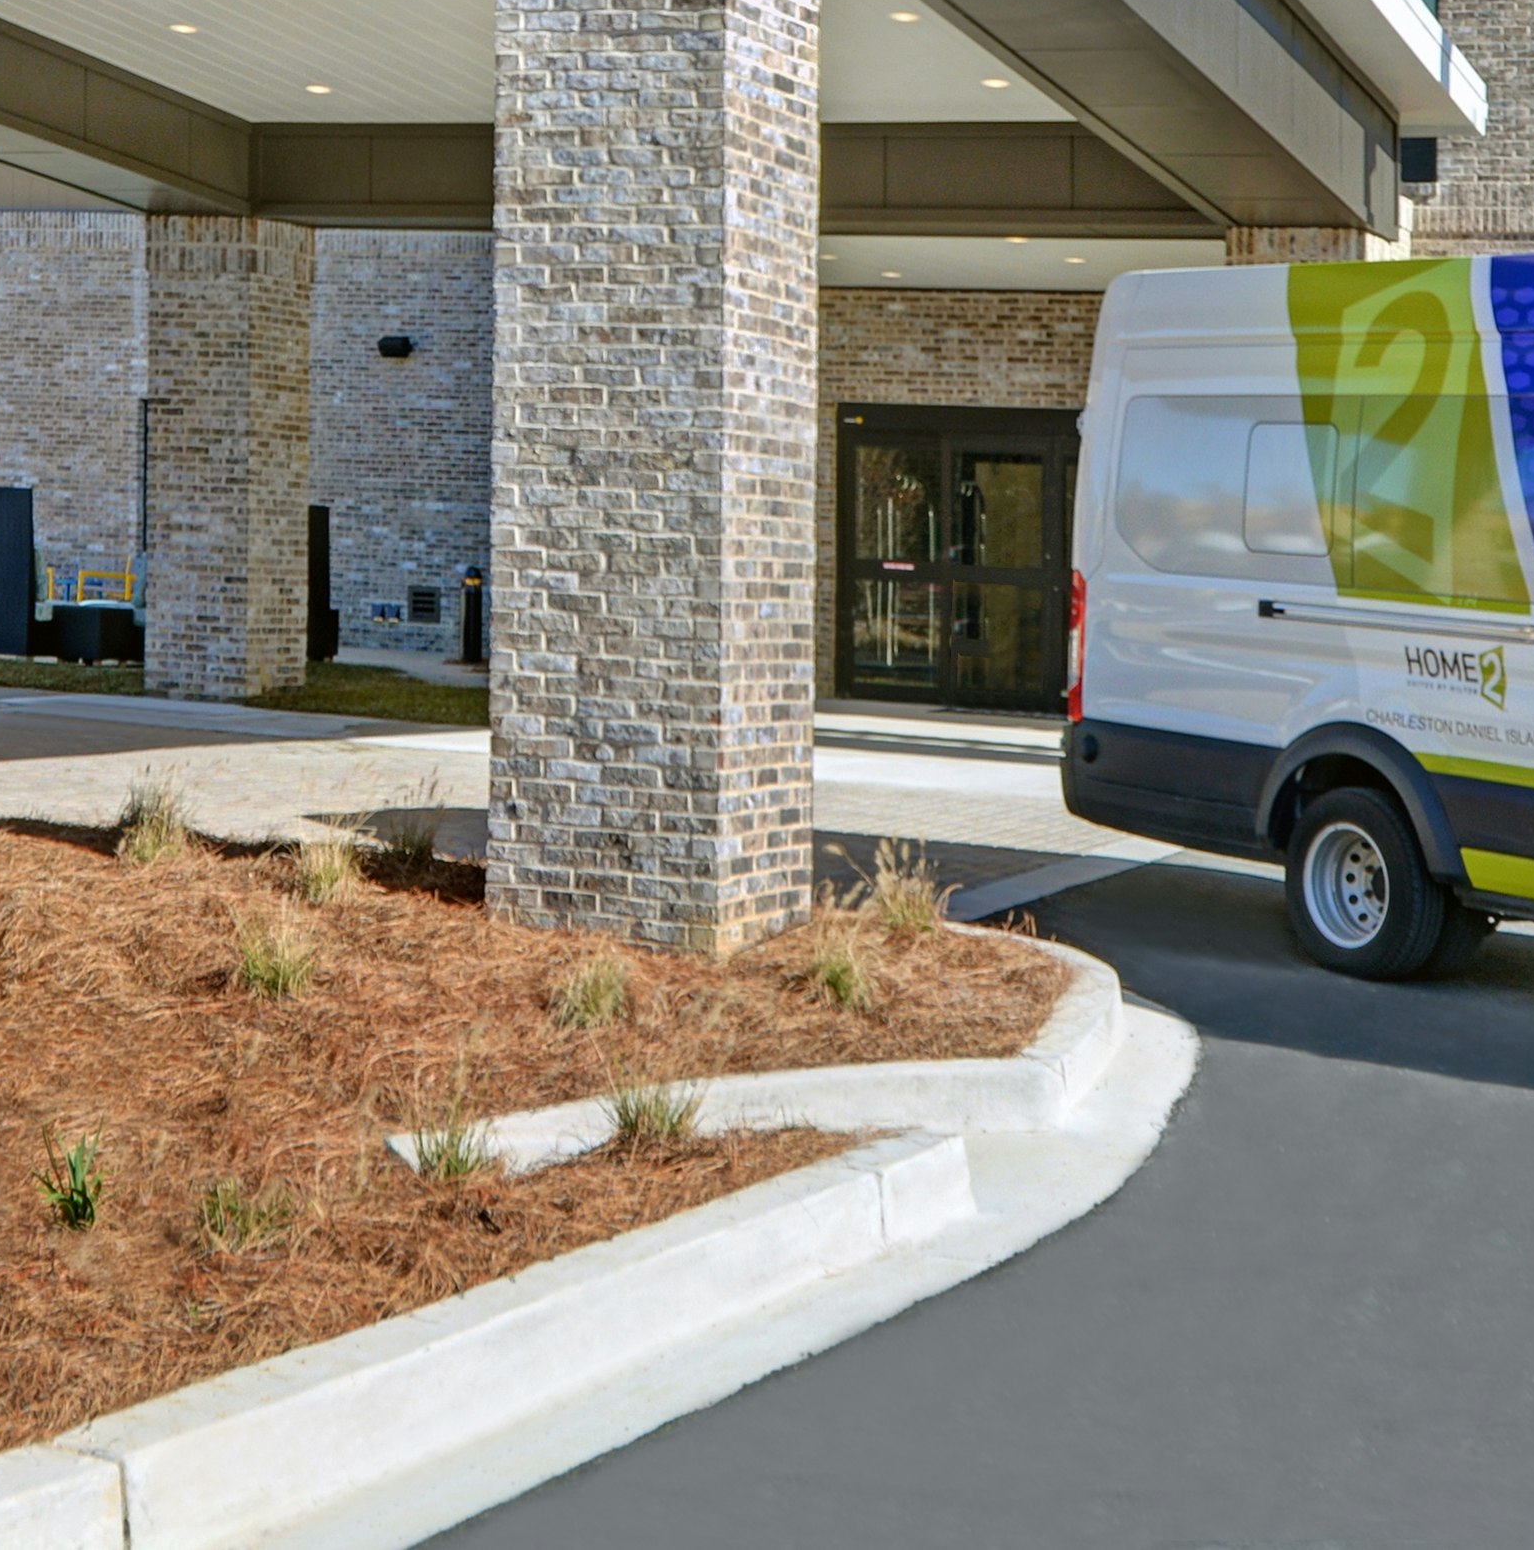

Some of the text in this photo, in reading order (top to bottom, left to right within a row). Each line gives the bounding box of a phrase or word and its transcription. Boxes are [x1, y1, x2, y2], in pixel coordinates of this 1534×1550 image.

[1339, 290, 1453, 565] 2
[1405, 646, 1503, 705] HOME 2
[1366, 708, 1454, 735] CHARLESTON
[1455, 720, 1503, 743] DANIEL
